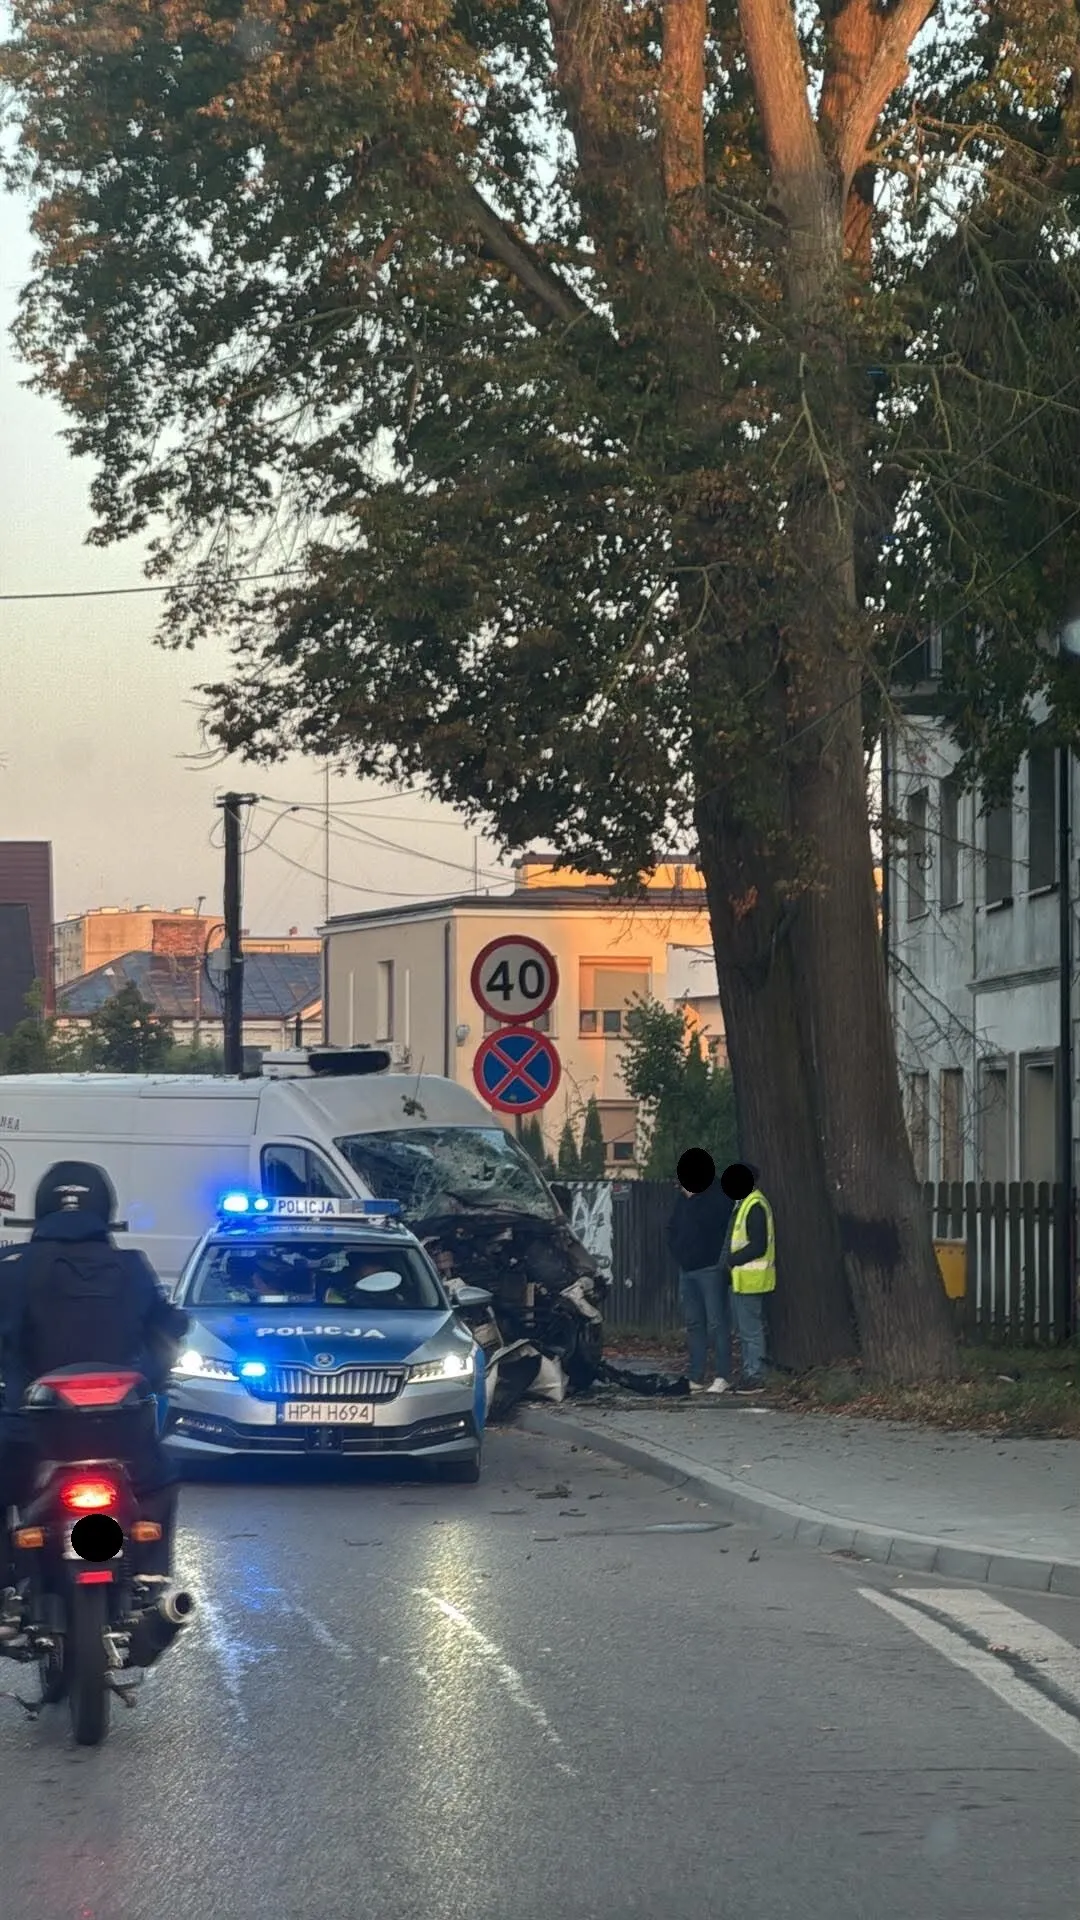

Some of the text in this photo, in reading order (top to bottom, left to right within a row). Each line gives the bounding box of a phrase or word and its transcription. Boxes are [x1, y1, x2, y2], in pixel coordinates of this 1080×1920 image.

[486, 959, 545, 1001] 40
[278, 1200, 335, 1214] POLICJA
[256, 1325, 386, 1339] POLICJA
[288, 1404, 370, 1422] HPH H694
